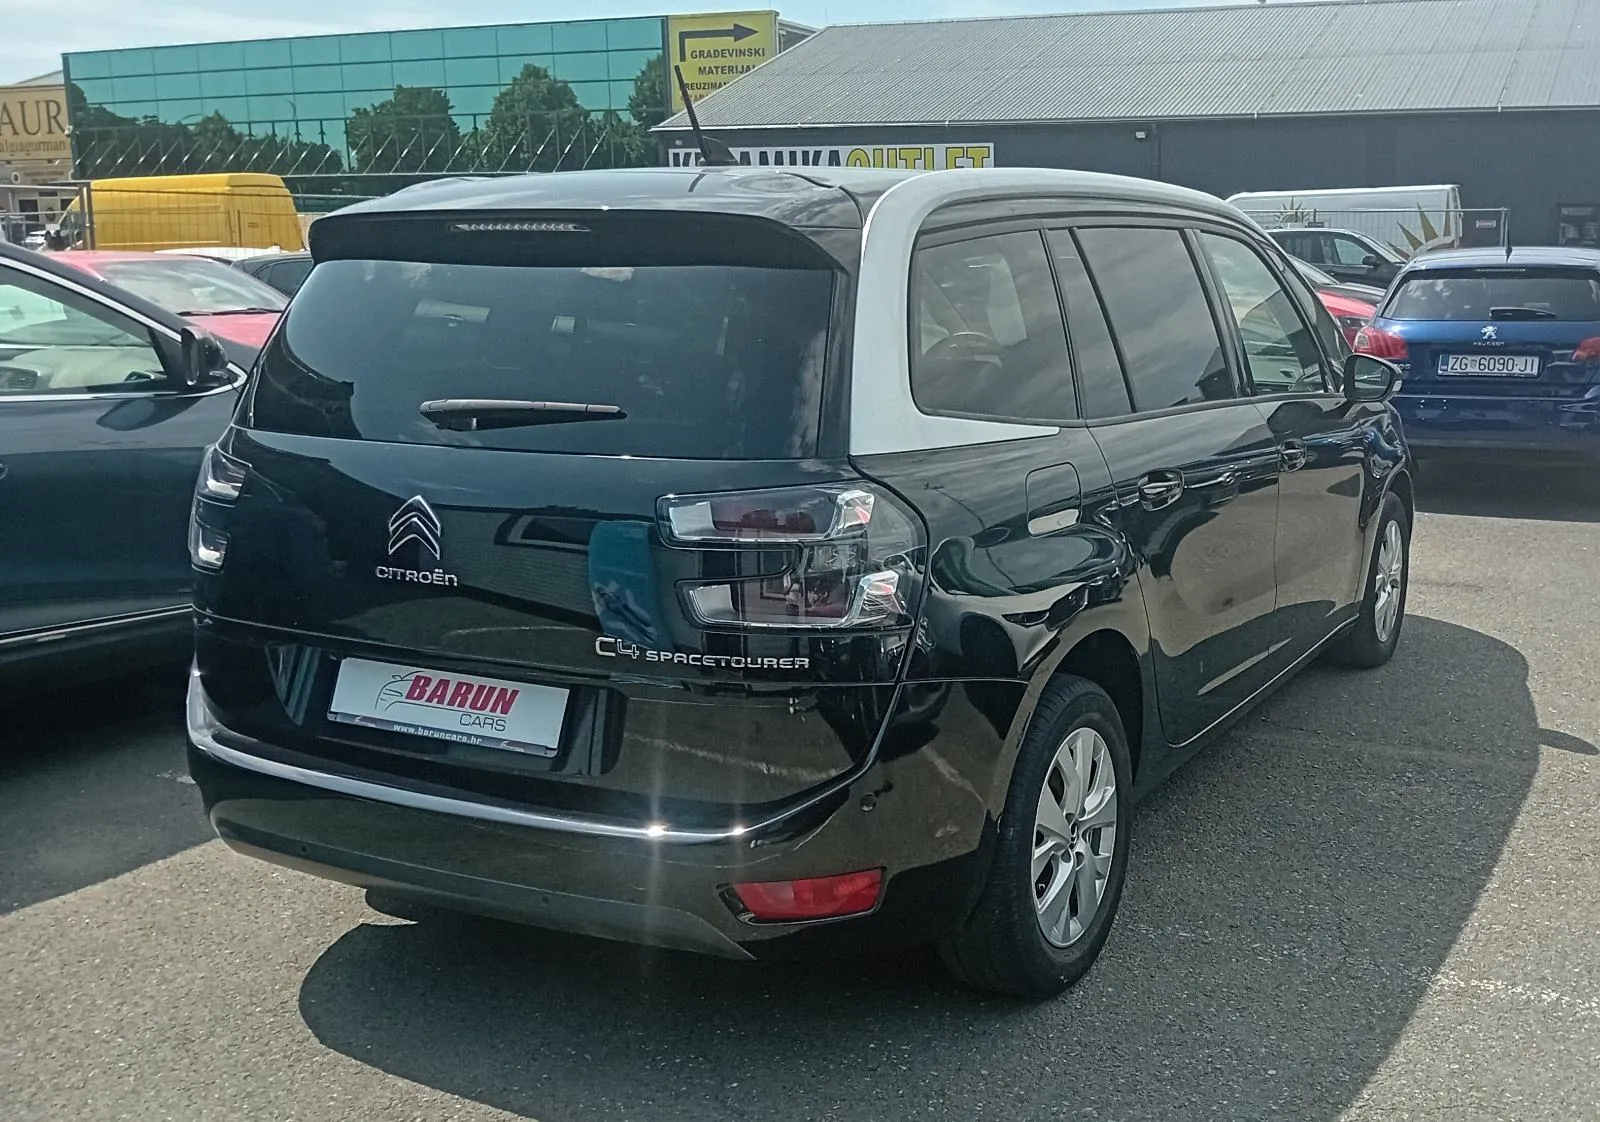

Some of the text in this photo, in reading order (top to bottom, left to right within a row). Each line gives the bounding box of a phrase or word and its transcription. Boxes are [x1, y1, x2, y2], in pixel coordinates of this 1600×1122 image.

[1450, 356, 1469, 371] ZG
[595, 636, 810, 669] C4 SPACETOURER
[405, 674, 520, 716] BARUN
[459, 713, 507, 732] CARS
[393, 723, 483, 745] www.baruncars.hr
